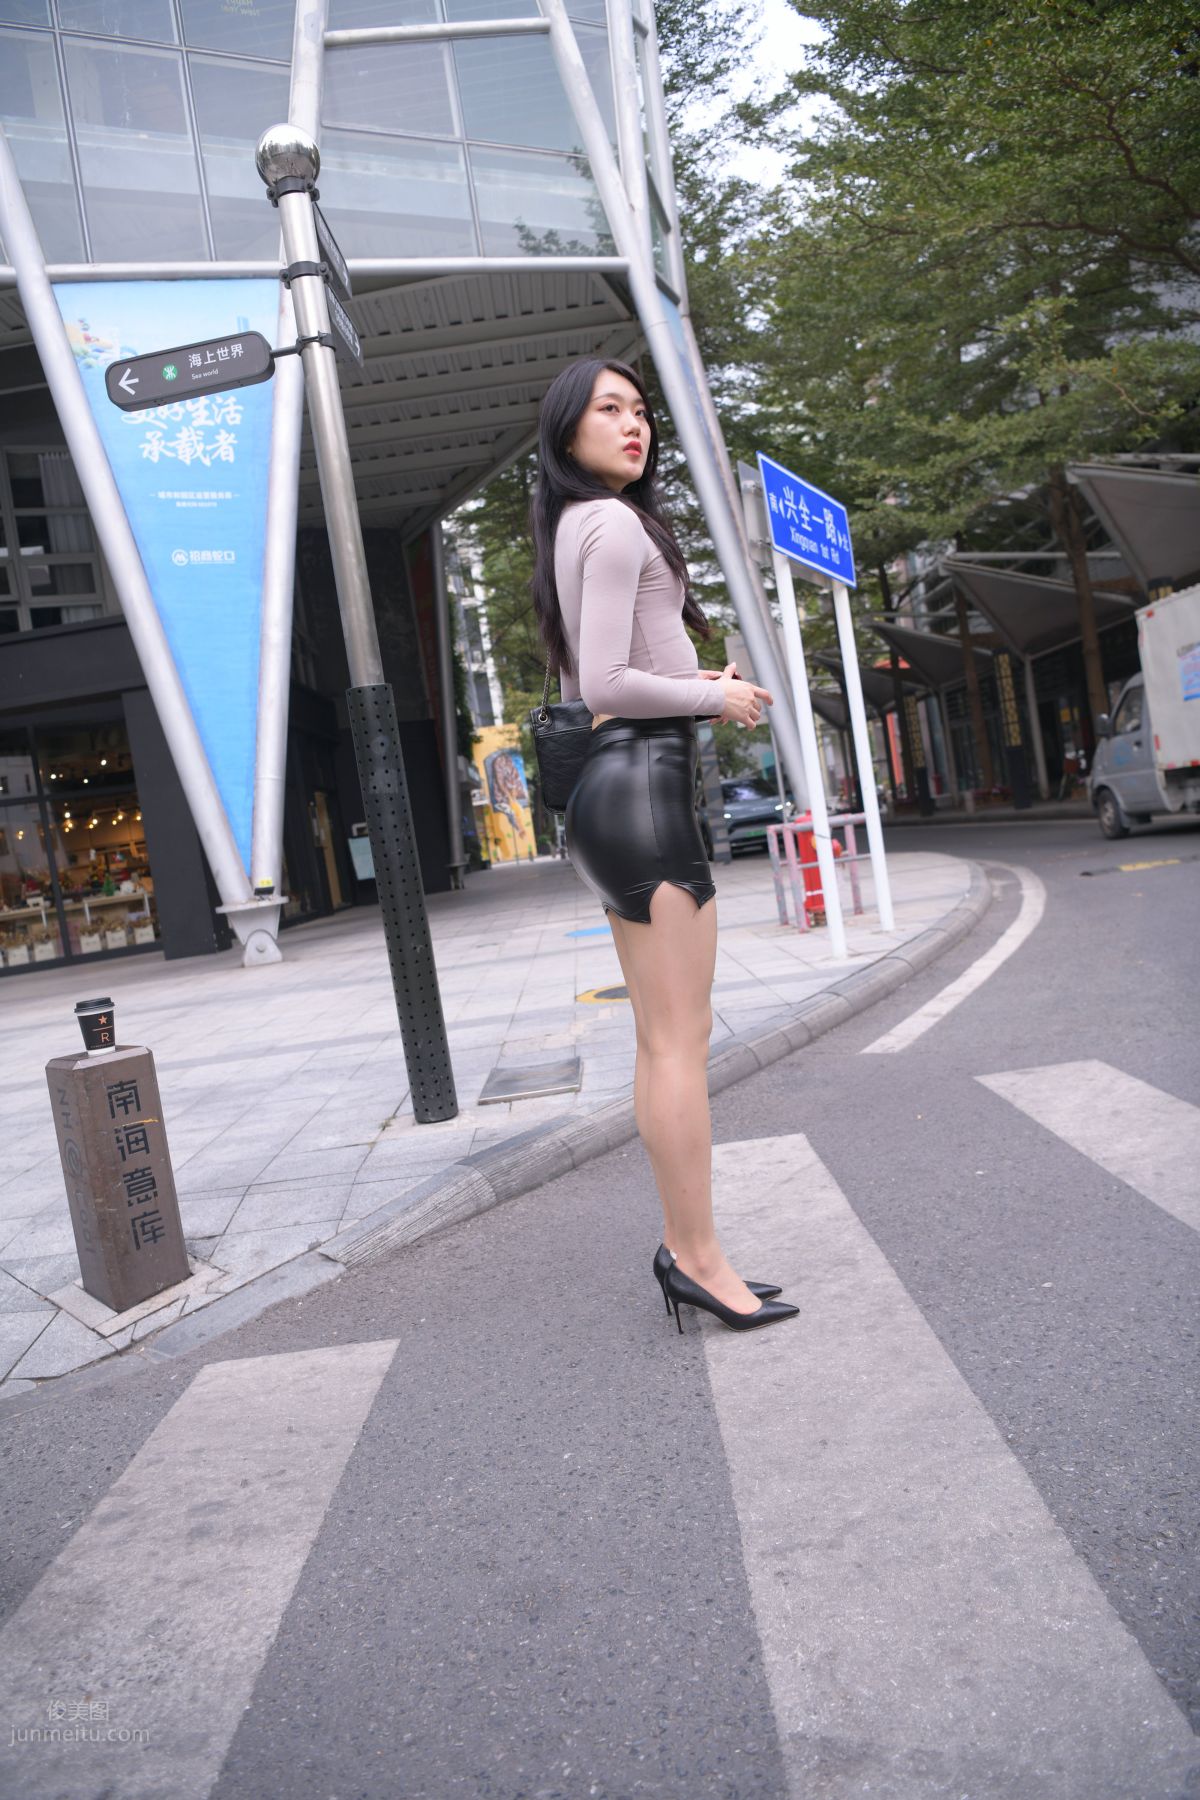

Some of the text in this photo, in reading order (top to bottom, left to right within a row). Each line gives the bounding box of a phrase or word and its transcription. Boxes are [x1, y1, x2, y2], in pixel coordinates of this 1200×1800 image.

[189, 343, 244, 368] 海上世界
[203, 368, 219, 377] world
[138, 427, 238, 467] 承载者
[783, 485, 837, 546] 兴全一路
[101, 1032, 110, 1043] R
[106, 1079, 166, 1251] 南海意库
